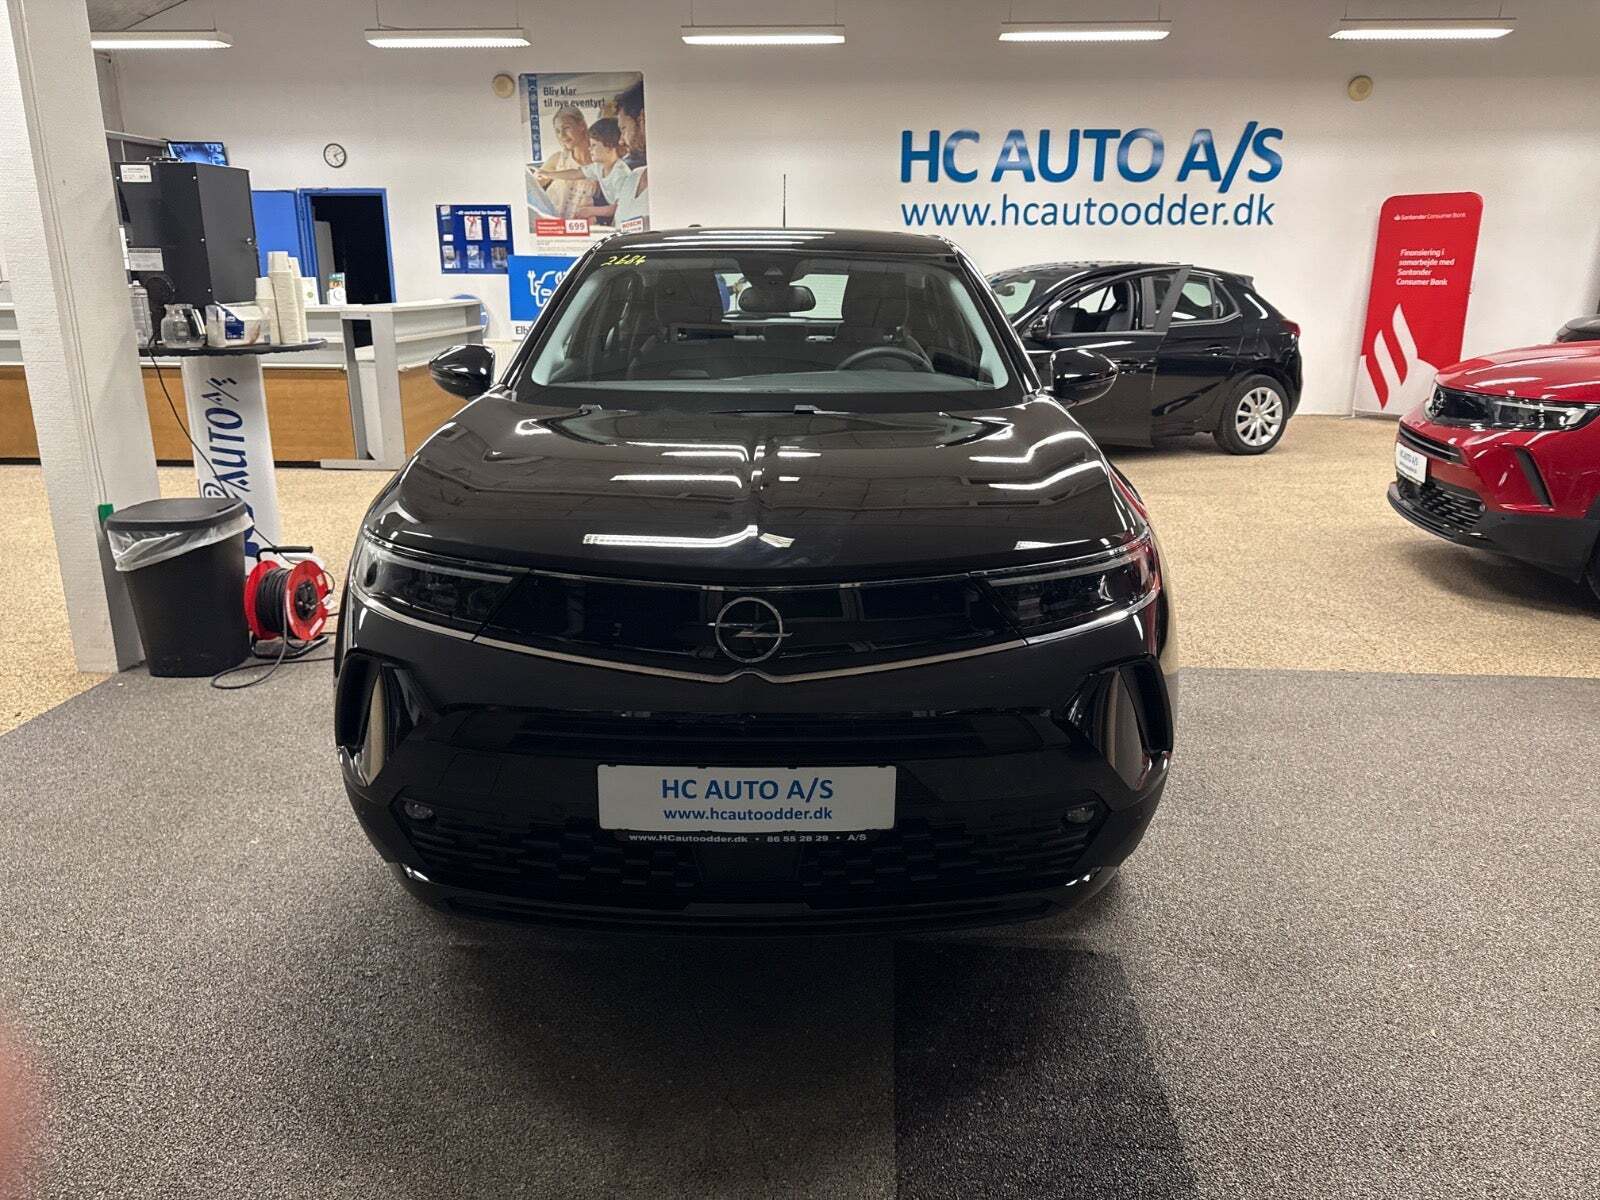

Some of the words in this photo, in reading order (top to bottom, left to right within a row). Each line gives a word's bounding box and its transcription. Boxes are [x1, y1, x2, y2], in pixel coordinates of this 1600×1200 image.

[543, 86, 559, 96] Bliv
[560, 86, 577, 96] klar
[543, 98, 553, 108] til
[554, 100, 570, 110] nye
[900, 128, 980, 183] HC
[991, 128, 1165, 183] AUTO
[1177, 121, 1284, 193] A/S
[901, 193, 1275, 226] www.hcautoodder.dk
[568, 222, 586, 231] 699
[1400, 248, 1441, 257] Finansiering
[1398, 258, 1439, 268] samarbejde
[1438, 258, 1456, 266] med
[1397, 268, 1432, 276] Santander
[1395, 277, 1429, 286] Consumer
[1429, 277, 1448, 286] Bank
[515, 325, 531, 335] Elb
[205, 407, 251, 492] AUTO
[661, 778, 697, 800] HC
[704, 778, 779, 800] AUTO
[787, 776, 834, 803] A/S
[663, 806, 833, 821] www.hcautoodder.dk
[628, 834, 748, 843] www.HCautoodder.dk
[782, 834, 797, 842] 55
[799, 834, 813, 842] 28
[847, 833, 867, 841] A/S
